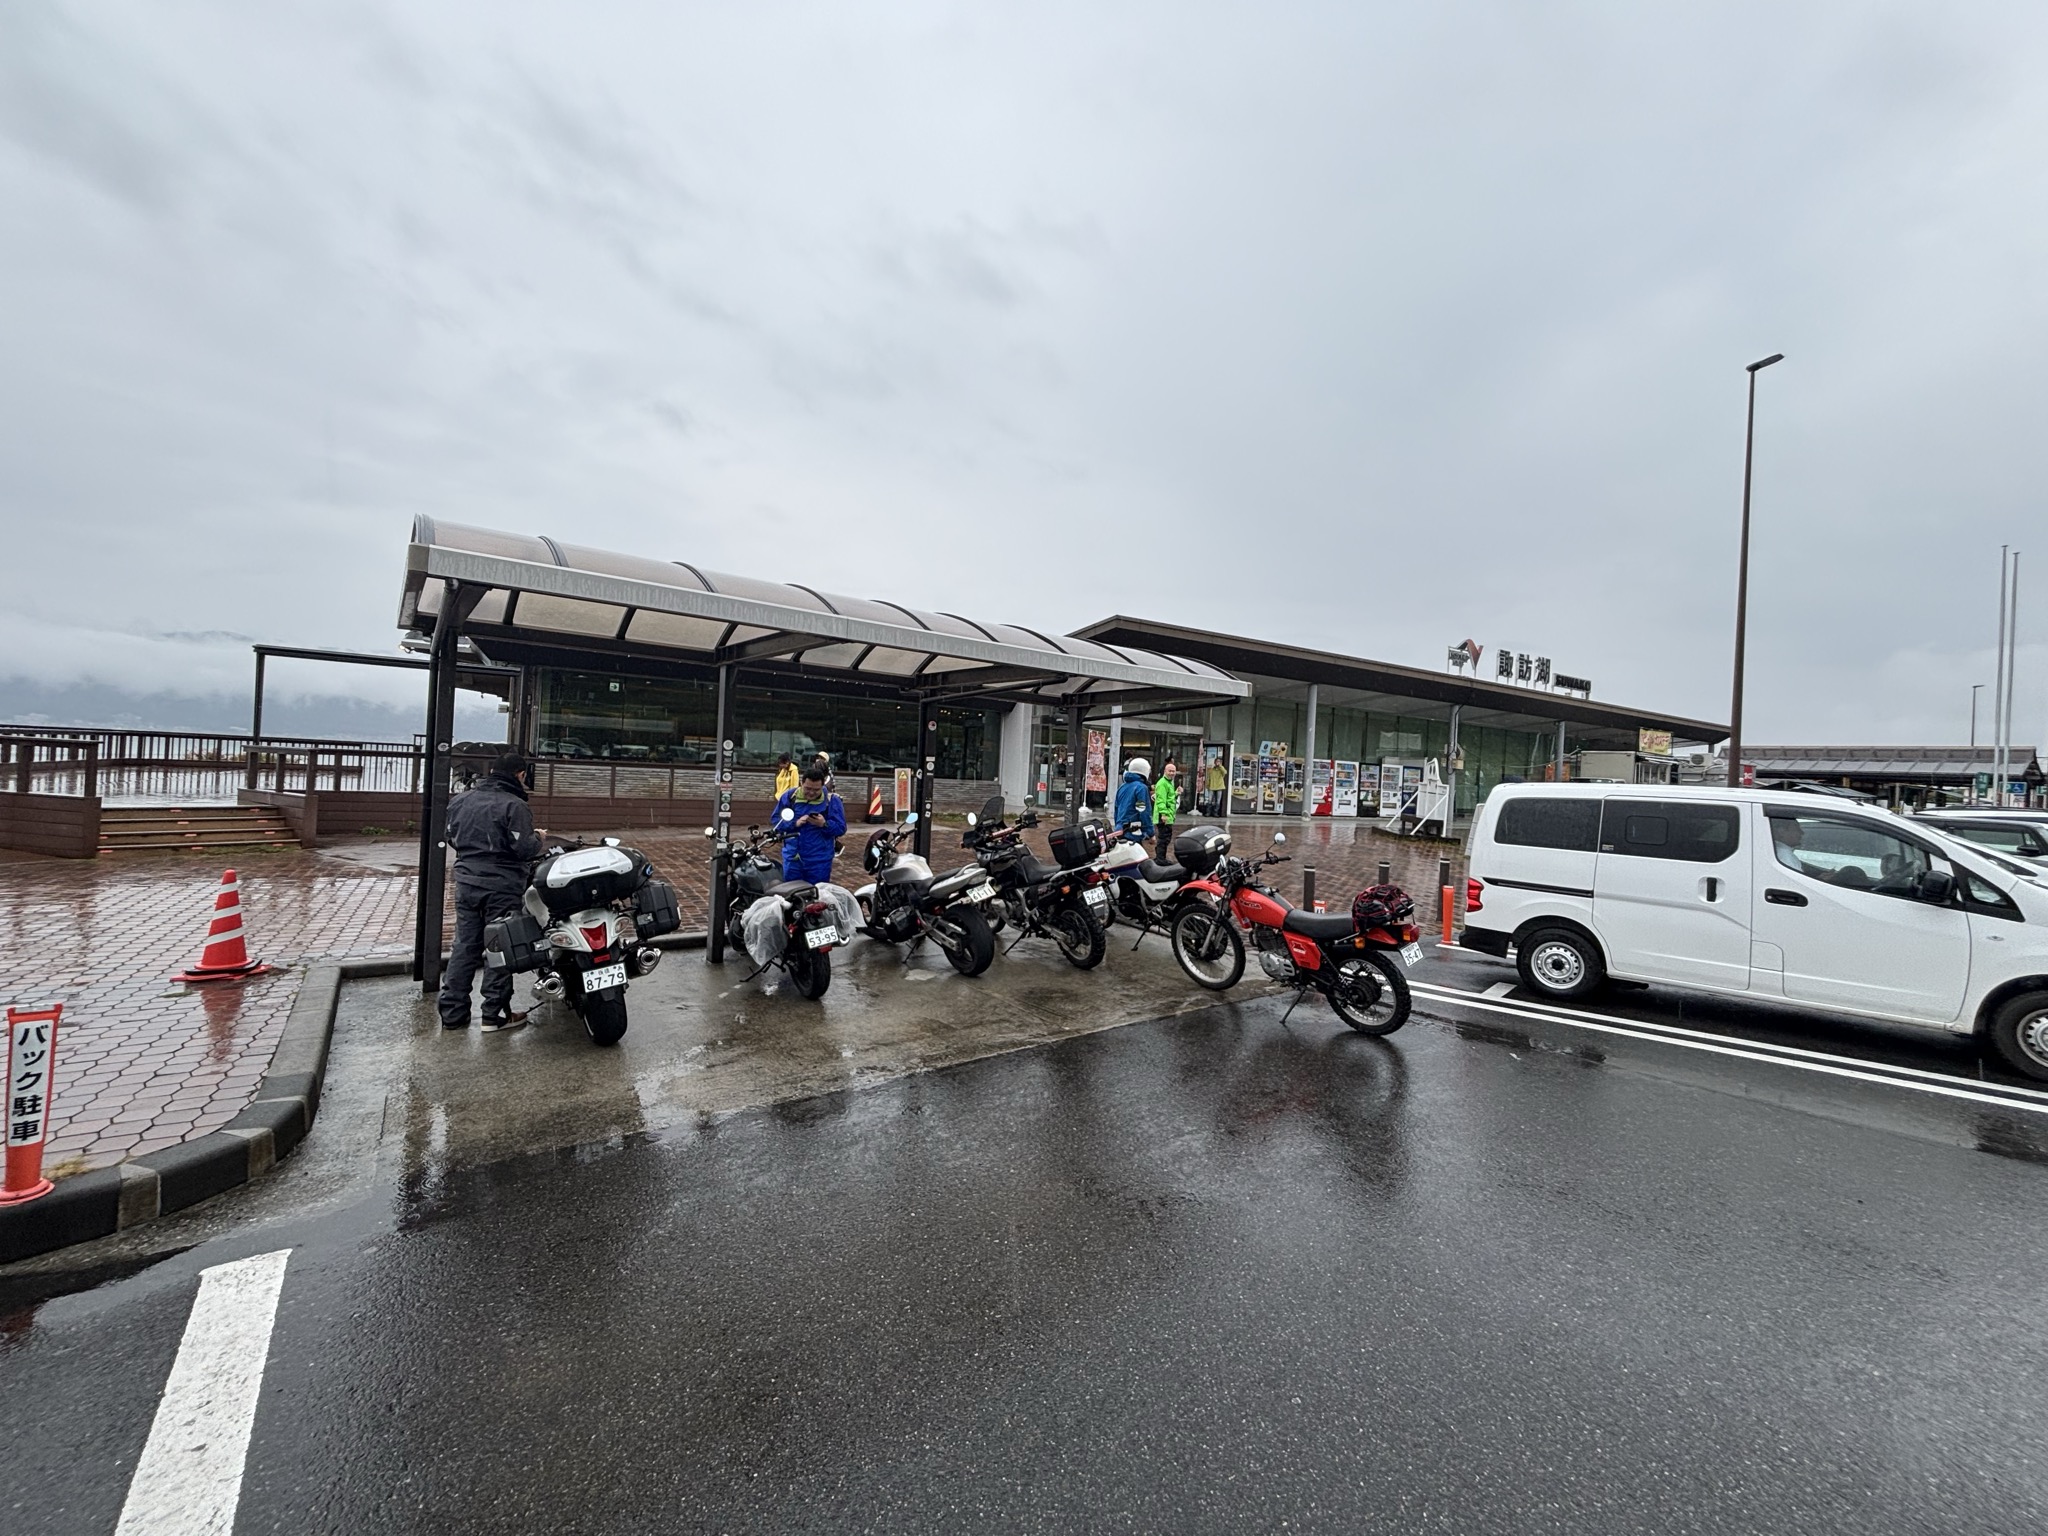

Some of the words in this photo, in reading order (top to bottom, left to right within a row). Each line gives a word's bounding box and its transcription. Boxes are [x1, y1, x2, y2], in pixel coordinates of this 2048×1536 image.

[1498, 649, 1551, 685] 諏訪湖
[809, 931, 837, 947] 53-95
[586, 972, 625, 991] 87-79
[10, 1024, 49, 1142] バック駐車
